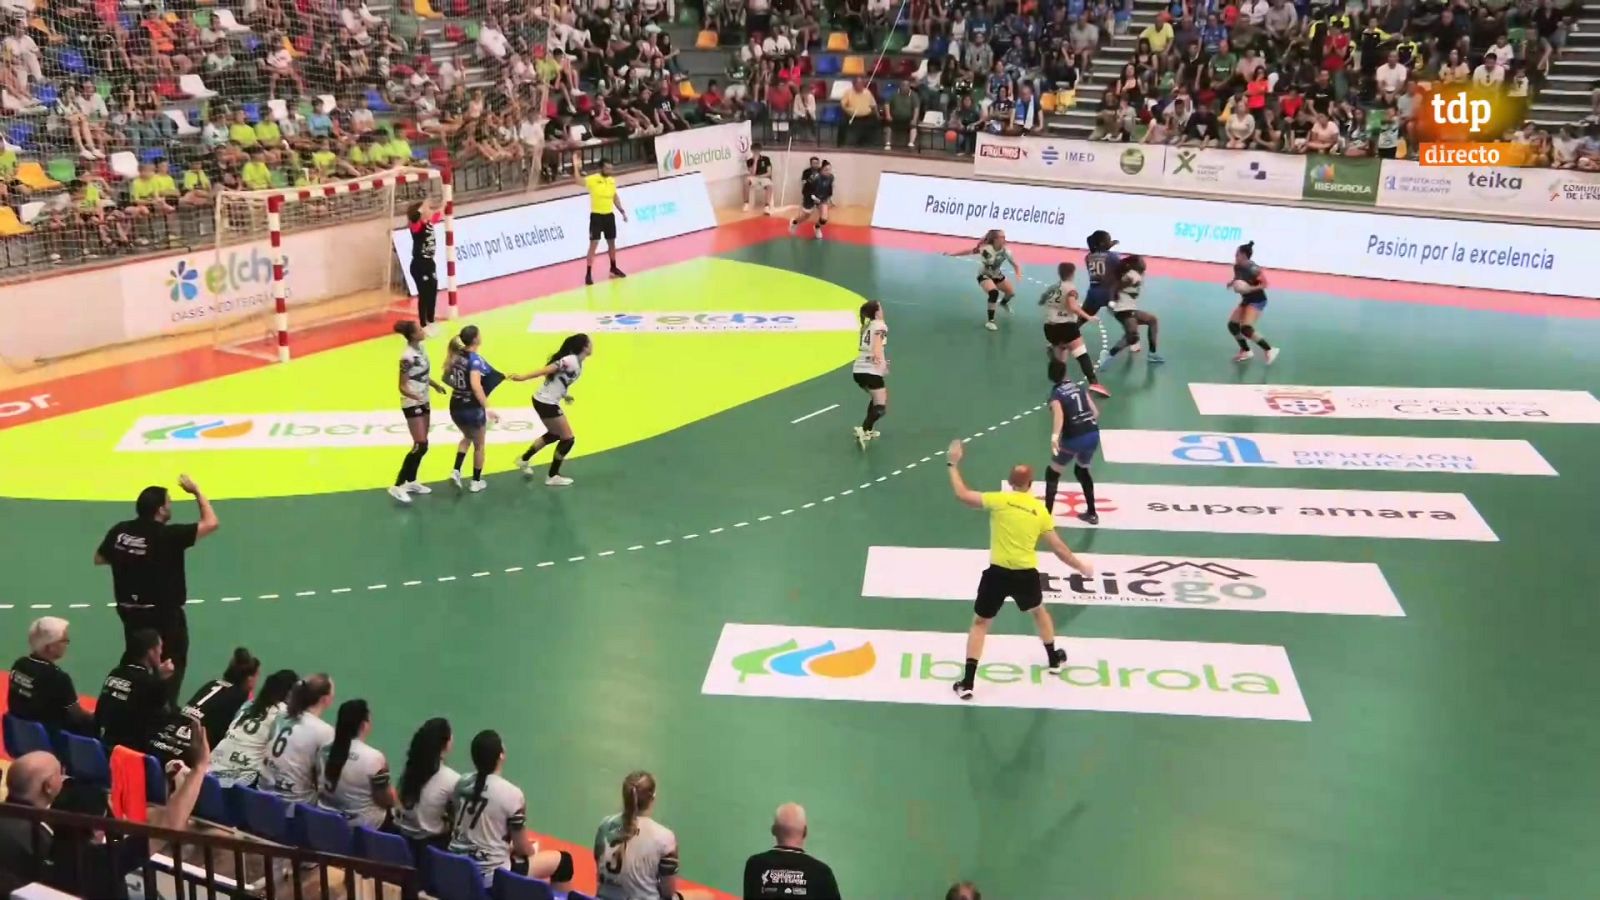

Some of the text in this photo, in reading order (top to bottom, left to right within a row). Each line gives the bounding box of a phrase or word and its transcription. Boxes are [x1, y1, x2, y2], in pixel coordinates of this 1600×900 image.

[683, 145, 732, 167] Iberdrola
[1065, 152, 1095, 162] IMED
[1314, 182, 1372, 194] IBERDROLA
[1468, 171, 1523, 190] teika
[925, 194, 1066, 226] Pasión por la excelencia
[1174, 221, 1243, 242] sacyr.com
[455, 242, 485, 261] asión
[484, 237, 501, 258] por
[502, 234, 513, 252] la
[514, 223, 565, 250] excelencia
[1366, 234, 1555, 270] Pasión por la excelencia
[1088, 260, 1106, 276] 20
[1071, 393, 1084, 412] 7
[1393, 402, 1550, 417] Ceuta
[1147, 502, 1457, 521] super amara
[900, 651, 1280, 696] Iberdrola
[272, 726, 293, 758] 6
